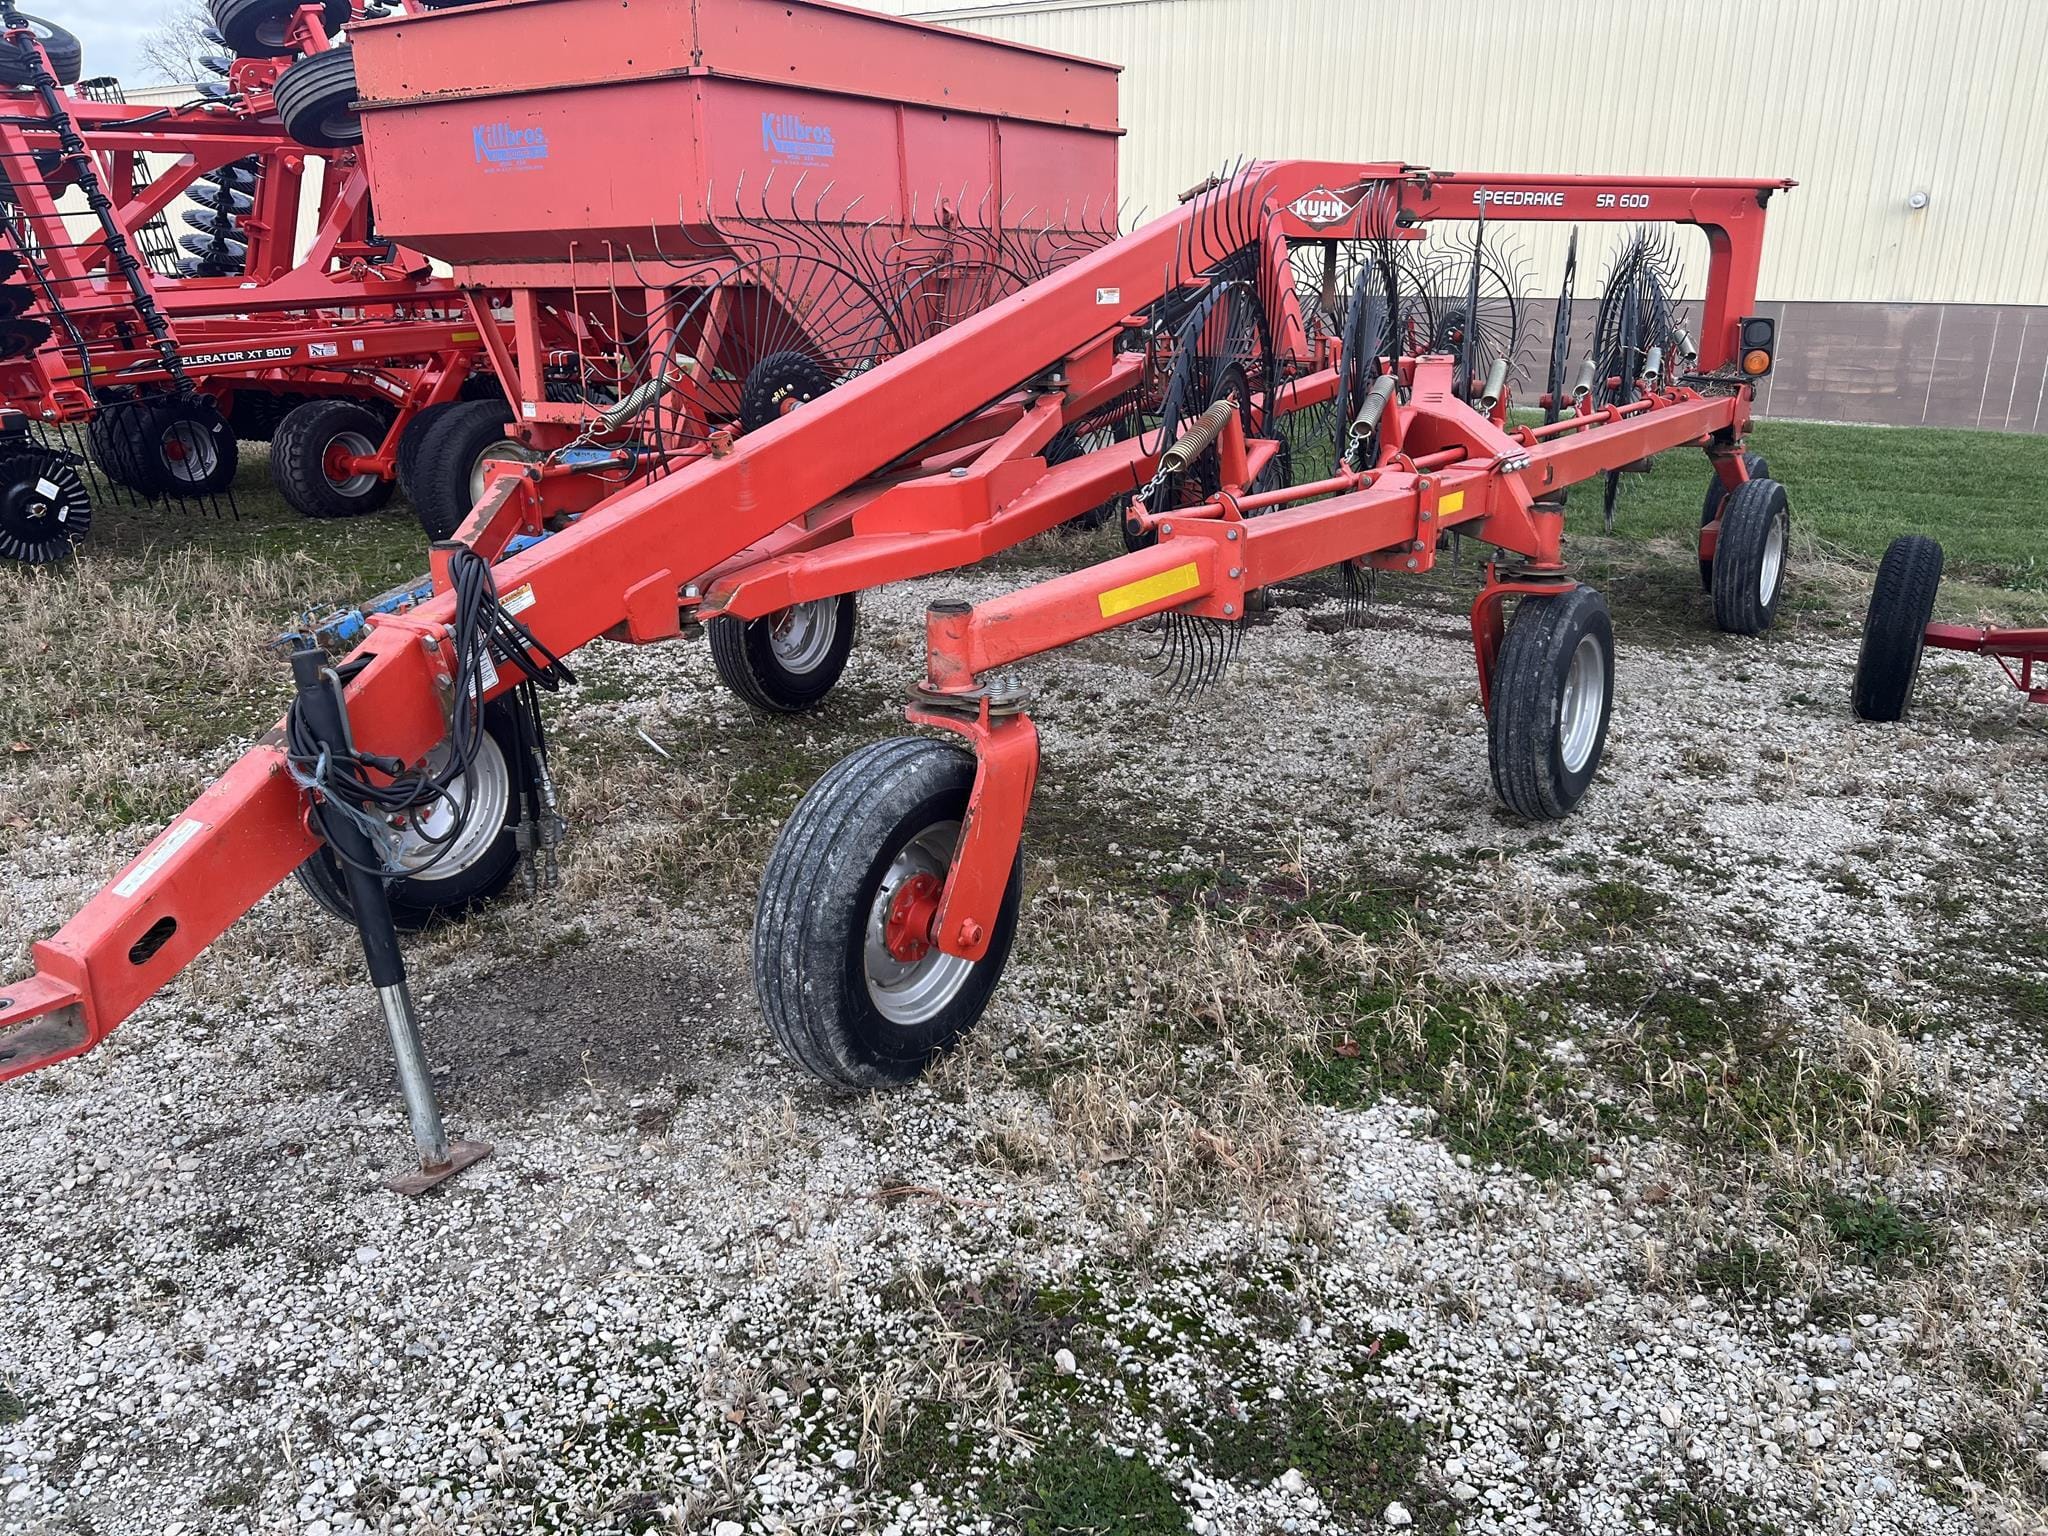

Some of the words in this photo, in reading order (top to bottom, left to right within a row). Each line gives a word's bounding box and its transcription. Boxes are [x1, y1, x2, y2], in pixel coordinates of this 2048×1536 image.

[1296, 199, 1343, 217] KUHN
[1472, 190, 1564, 206] SPEEDRAKE
[1596, 193, 1616, 207] SR
[1619, 194, 1649, 208] 600
[157, 351, 243, 367] ELERATOR
[247, 350, 263, 359] XT
[266, 347, 292, 357] 8010
